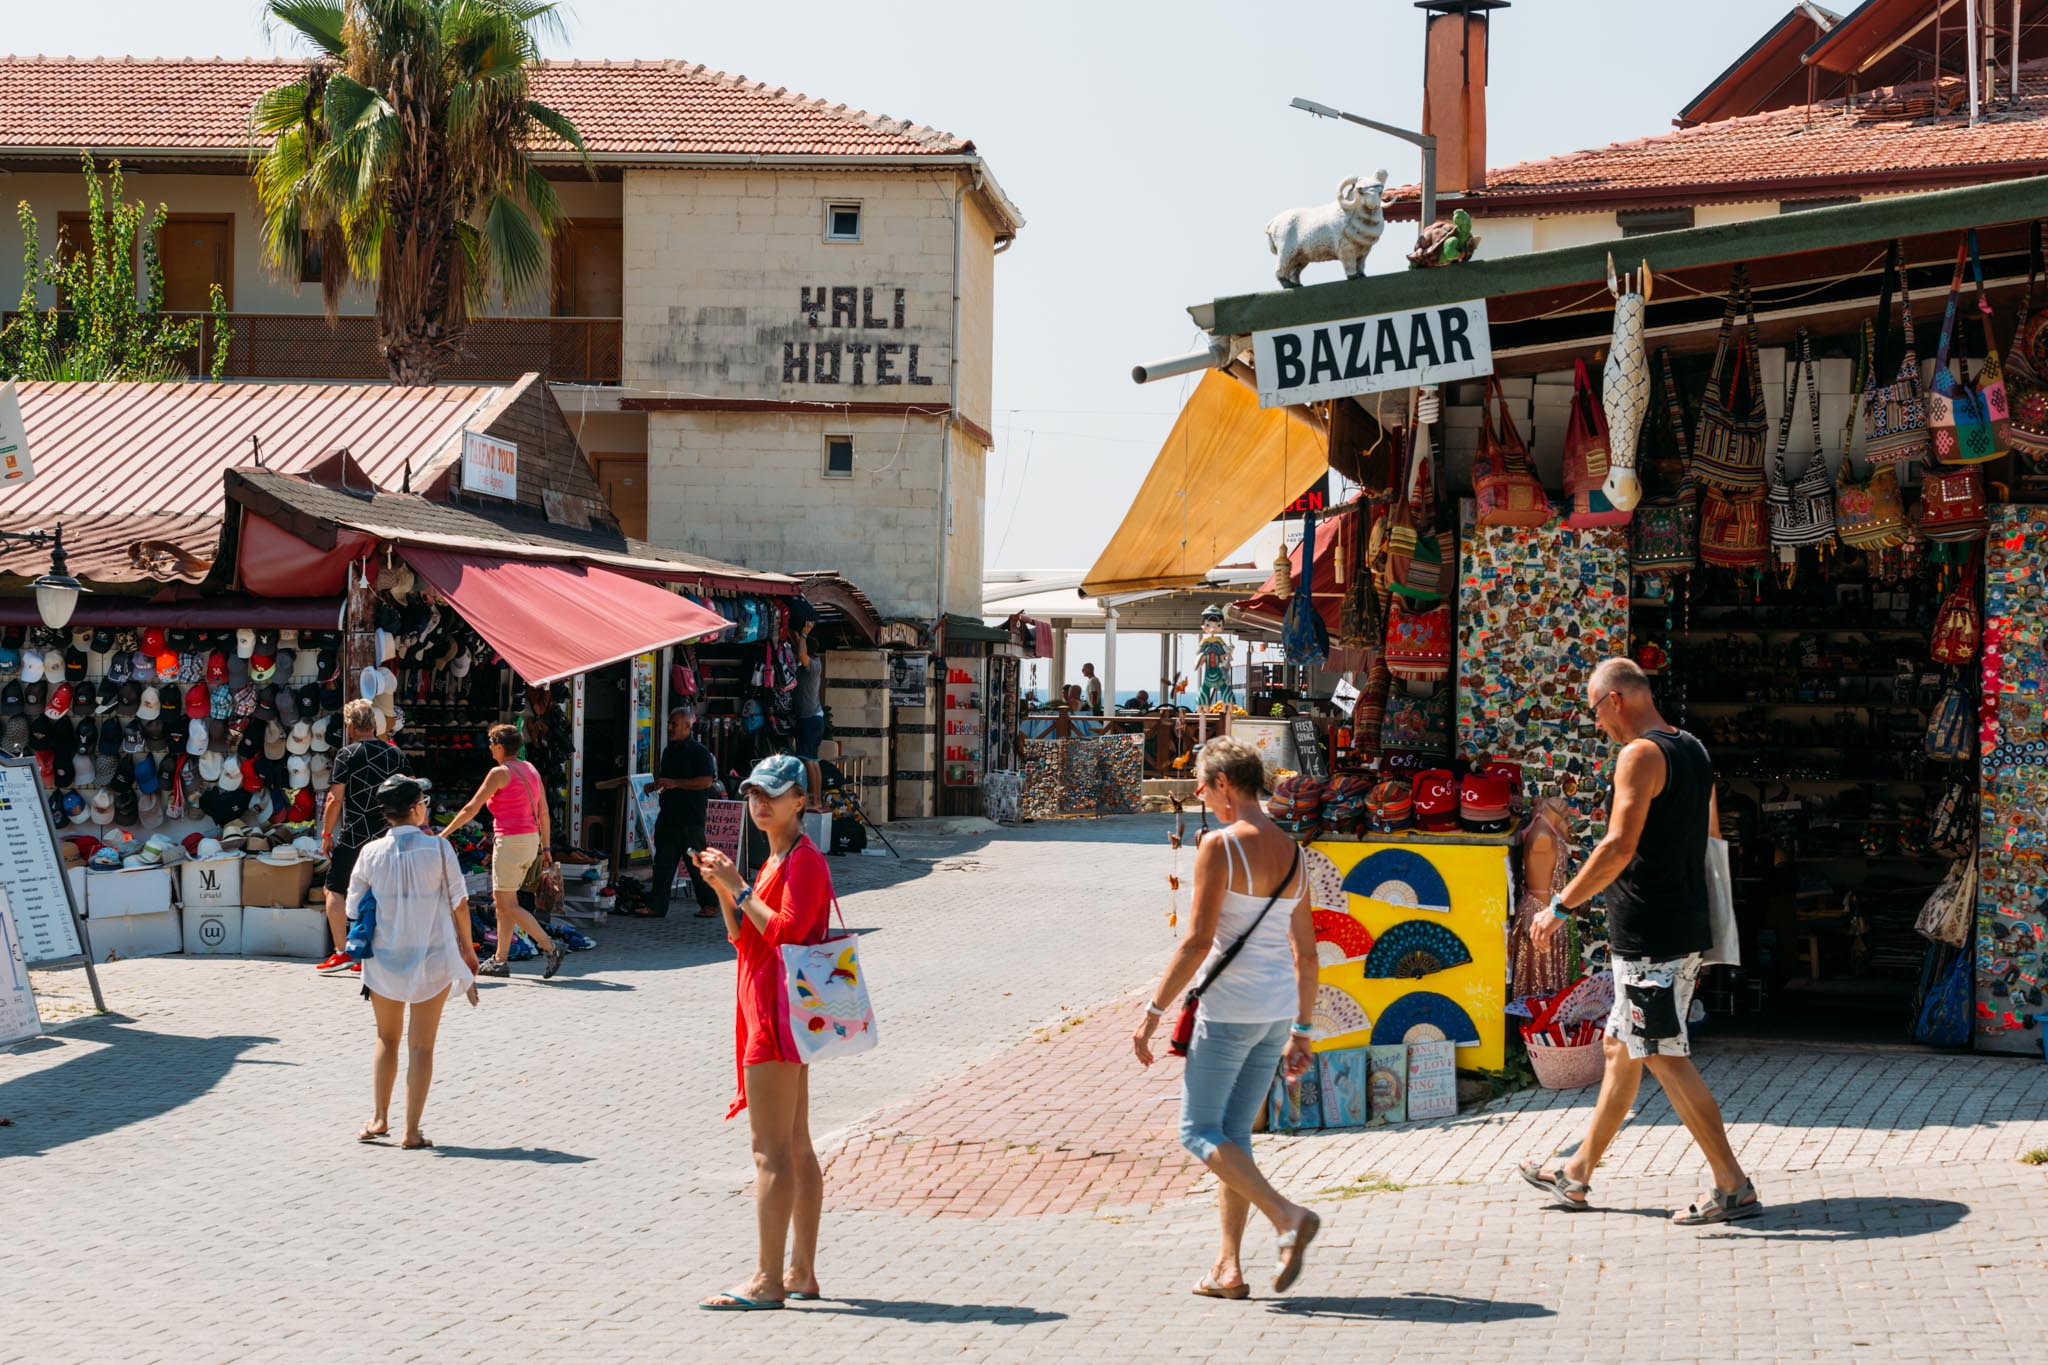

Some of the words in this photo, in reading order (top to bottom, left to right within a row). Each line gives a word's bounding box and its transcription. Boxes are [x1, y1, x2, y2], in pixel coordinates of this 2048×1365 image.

[801, 286, 905, 328] YALI
[783, 342, 933, 385] HOTEL
[1272, 307, 1475, 390] BAZAAR
[497, 448, 515, 477] TOUR
[1424, 1058, 1452, 1070] LOVE
[1408, 1079, 1435, 1090] SING
